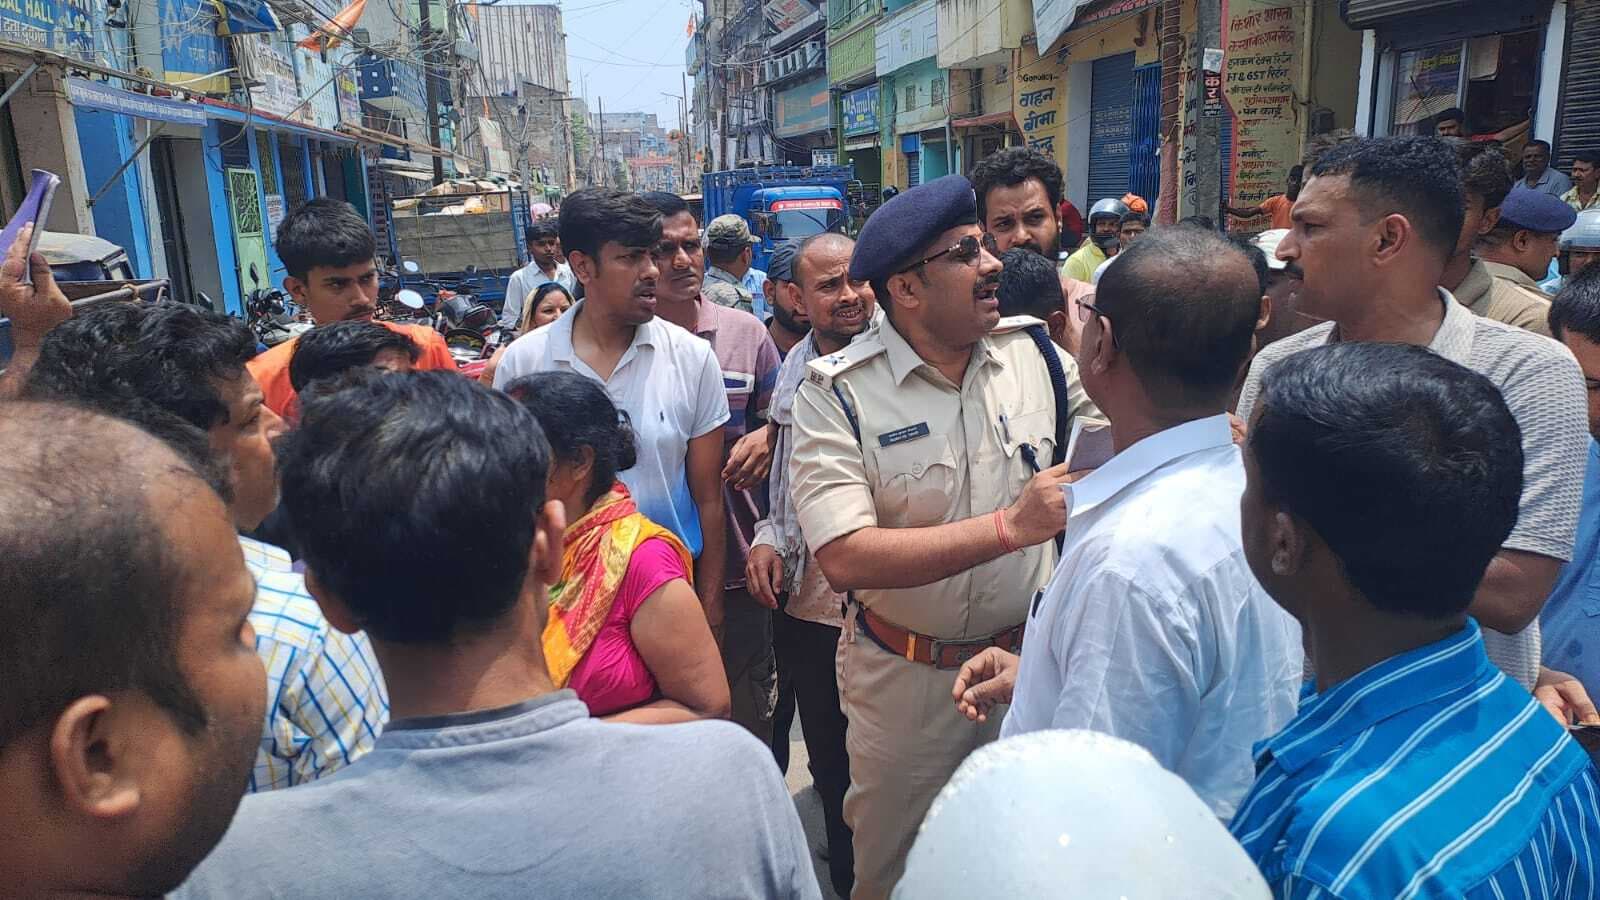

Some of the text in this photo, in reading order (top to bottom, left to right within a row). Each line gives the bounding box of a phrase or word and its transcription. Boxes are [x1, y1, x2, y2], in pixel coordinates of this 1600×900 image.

[25, 0, 55, 25] HALL
[1020, 87, 1056, 107] वाहन
[1024, 111, 1057, 131] बीमा
